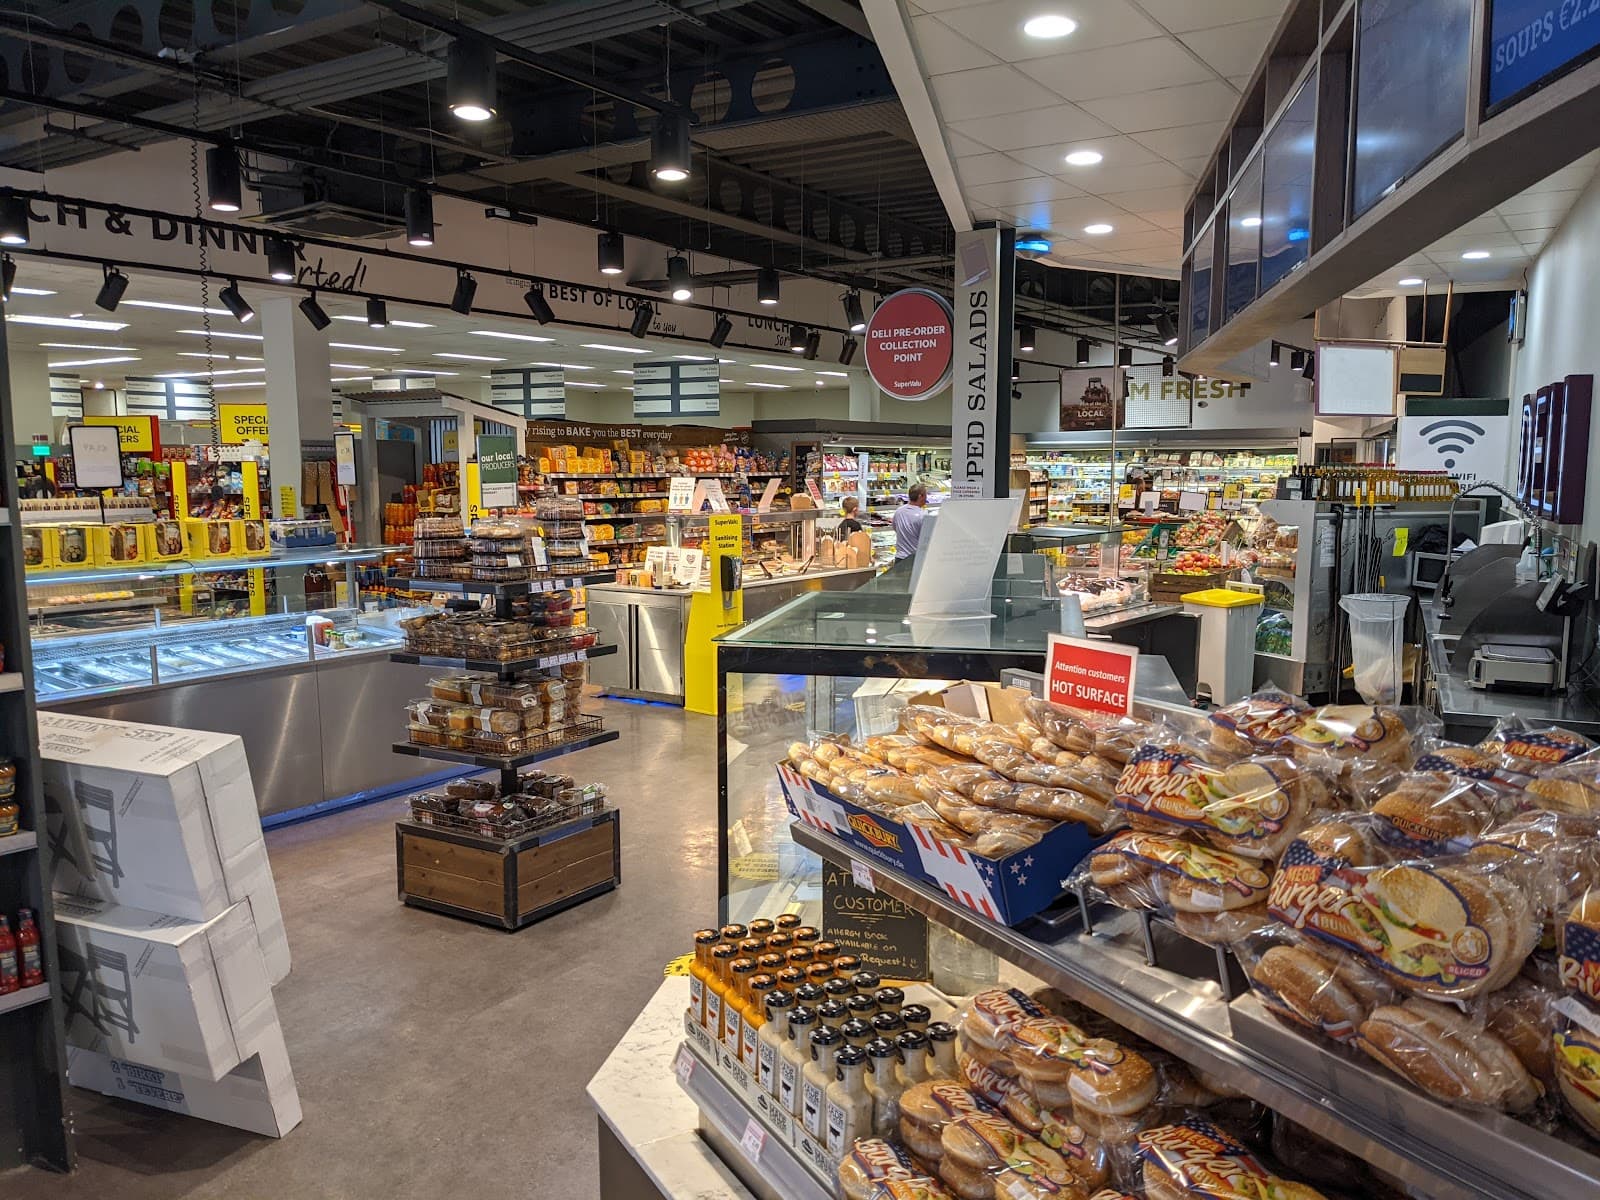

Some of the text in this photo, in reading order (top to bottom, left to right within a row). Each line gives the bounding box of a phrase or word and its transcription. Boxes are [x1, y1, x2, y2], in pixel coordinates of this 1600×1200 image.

[1495, 10, 1554, 72] SOUPS
[27, 199, 87, 229] CH
[105, 209, 134, 236] &
[550, 285, 588, 303] BEST
[593, 292, 613, 307] OF
[653, 317, 678, 333] to you
[748, 316, 790, 333] LUNCH
[871, 325, 945, 339] DELI PRE-ORDER
[879, 339, 937, 351] COLLECTION
[968, 290, 988, 411] SALADS
[893, 352, 923, 363] POINT
[893, 380, 922, 390] SuperValu
[1161, 379, 1247, 400] FRESH
[1077, 410, 1104, 418] LOCAL
[532, 425, 556, 438] rising
[557, 427, 565, 435] to
[566, 426, 592, 436] BAKE
[592, 428, 605, 439] you
[607, 427, 619, 438] the
[620, 428, 641, 438] BEST
[642, 430, 673, 441] everyday
[495, 451, 514, 461] local
[481, 461, 515, 471] PRODUCERS
[714, 519, 739, 527] SuperValu
[1055, 660, 1126, 684] Attention customers
[1052, 679, 1126, 708] HOT SURFACE
[1509, 743, 1562, 762] MEGA
[1137, 761, 1171, 775] MEGA
[1115, 764, 1197, 812] Burger
[847, 815, 898, 850] QUICKBURY
[1392, 816, 1448, 840] QUICKBURY
[1286, 867, 1317, 882] MEGA
[833, 894, 915, 917] CUSTOMER
[1267, 869, 1363, 929] Burger
[1448, 965, 1483, 977] SLICED
[1176, 1128, 1218, 1151] MEGA
